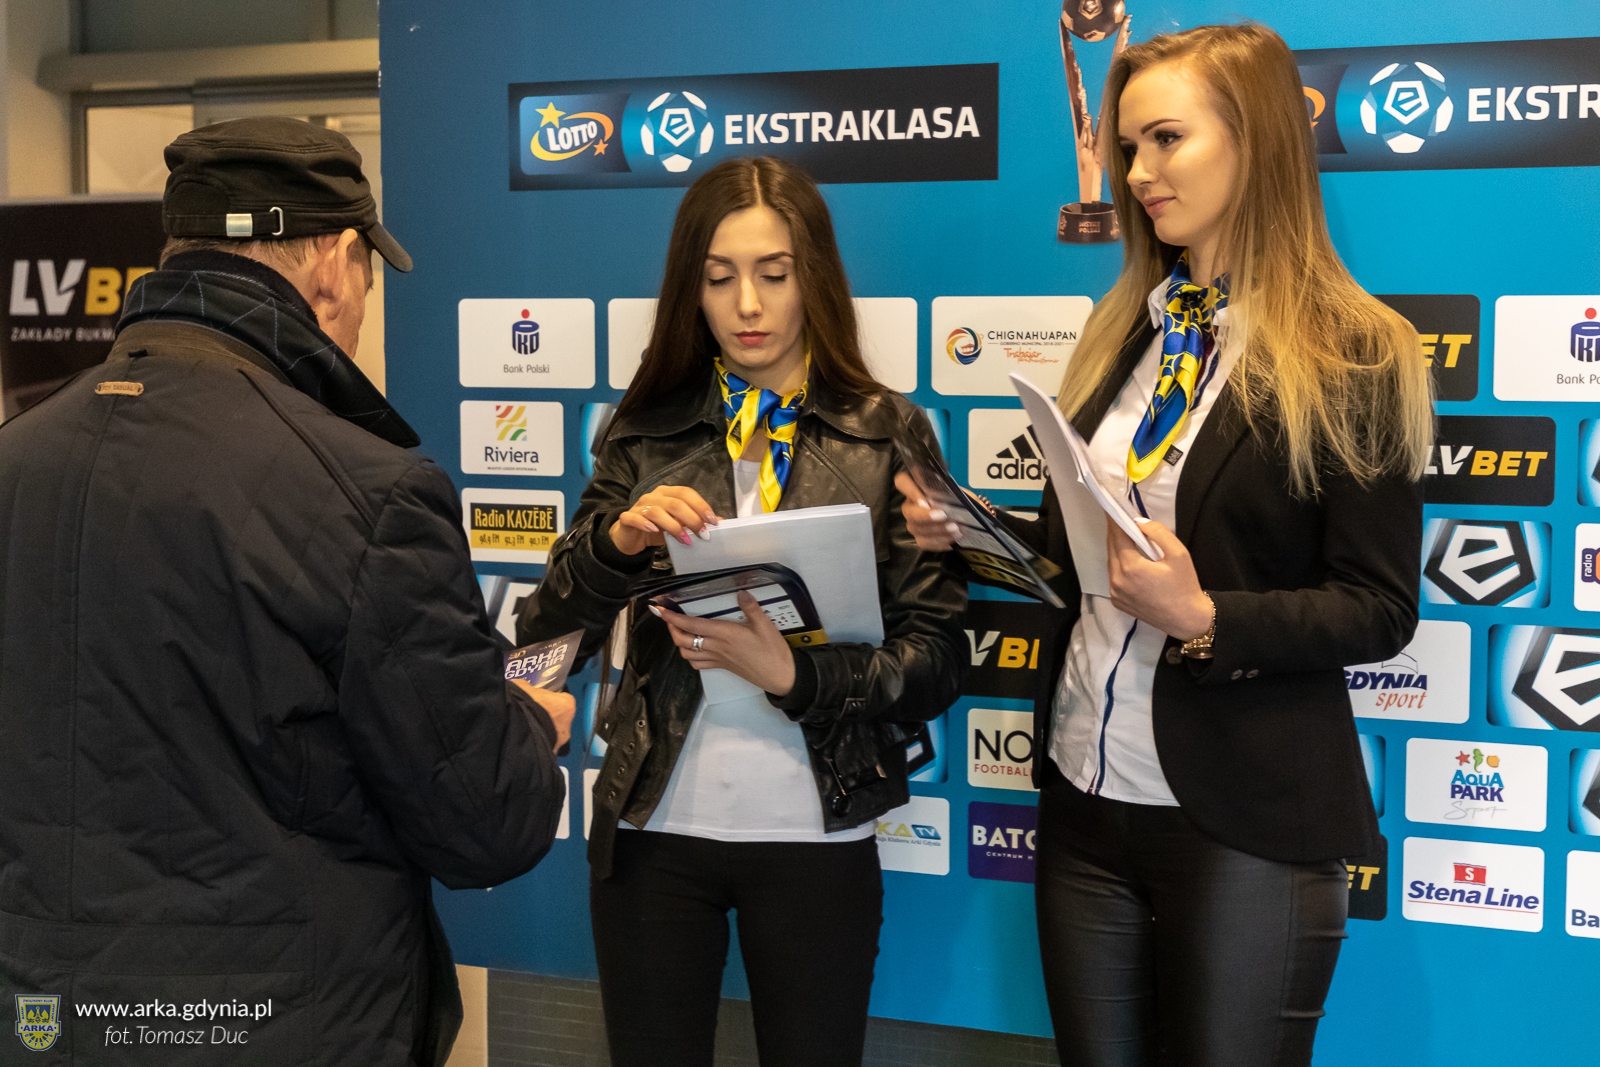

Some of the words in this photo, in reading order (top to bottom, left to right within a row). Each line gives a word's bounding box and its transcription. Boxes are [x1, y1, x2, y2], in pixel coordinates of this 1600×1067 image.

[1467, 83, 1600, 122] EKSTR
[546, 120, 598, 151] LOTTO
[724, 106, 981, 145] EKSTRAKLASA
[987, 330, 1077, 340] CHIGNAHUAPAN
[503, 364, 524, 373] Bank
[526, 364, 550, 373] Polski
[1556, 373, 1585, 384] Bank
[484, 446, 540, 463] Riviera
[474, 508, 505, 528] Radio
[1583, 553, 1593, 577] radio
[1375, 691, 1427, 712] sport
[1450, 784, 1504, 802] PARK
[916, 827, 936, 837] TV
[1464, 867, 1475, 881] S
[1407, 880, 1482, 904] Stena
[1484, 887, 1540, 910] Line
[1571, 908, 1600, 928] Ba
